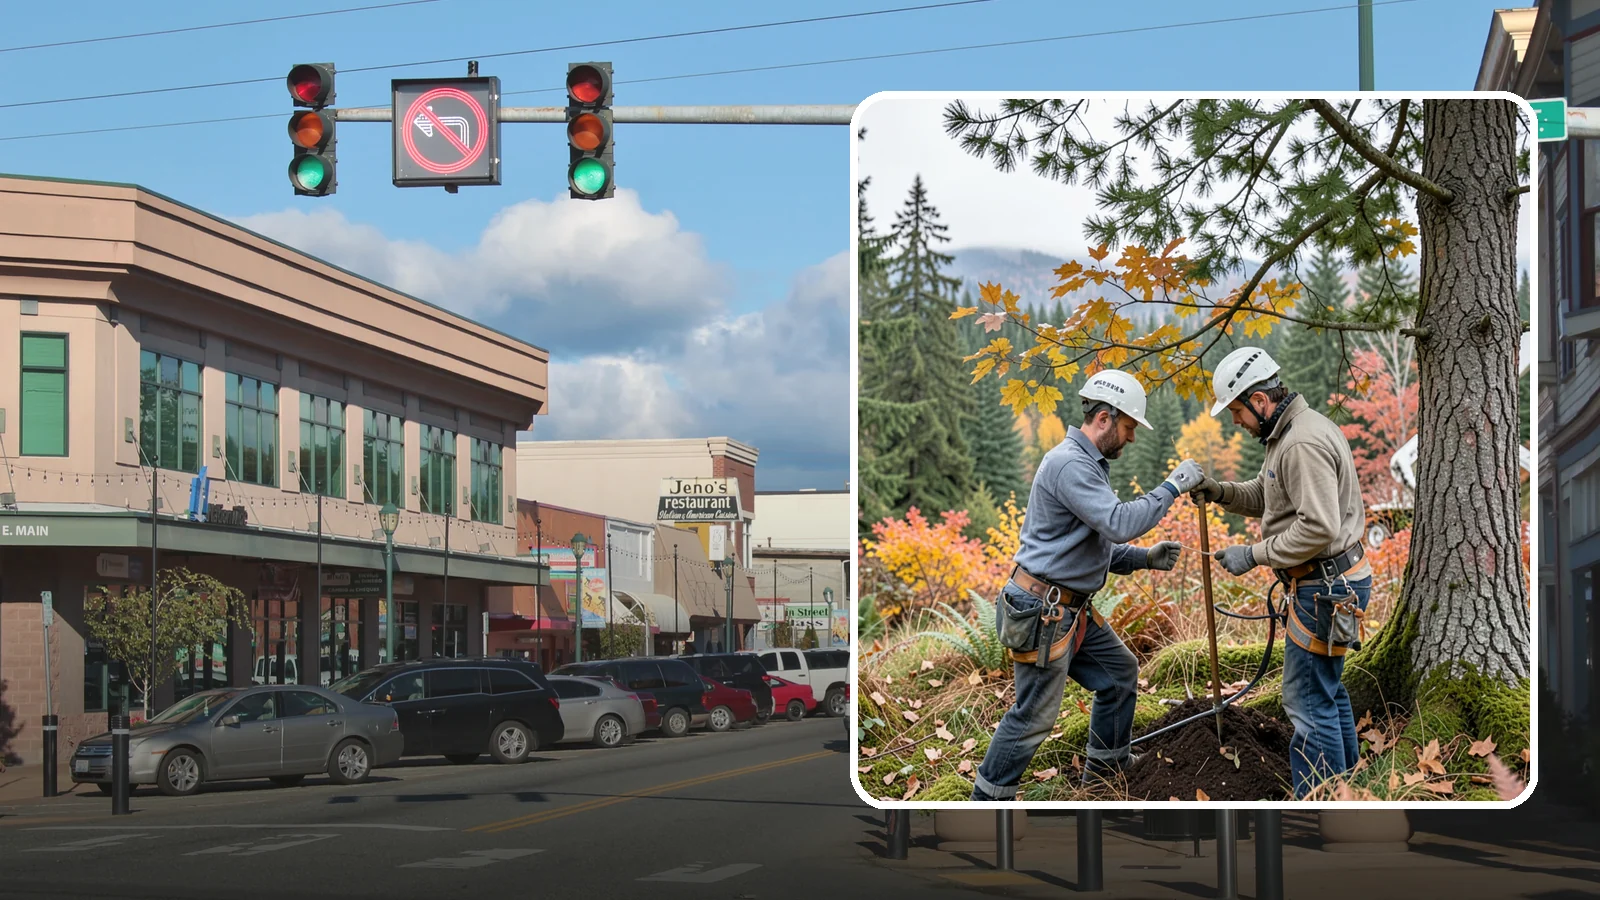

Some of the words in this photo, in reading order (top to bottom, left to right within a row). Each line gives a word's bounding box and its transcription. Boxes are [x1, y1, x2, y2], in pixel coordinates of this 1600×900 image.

[670, 480, 727, 494] Jeno's
[665, 496, 731, 509] restaurant
[659, 510, 681, 519] Italian
[686, 510, 714, 519] American
[715, 509, 737, 519] Cuisine
[2, 525, 12, 536] E.
[16, 525, 49, 536] MAIN
[797, 607, 828, 617] Street
[787, 619, 823, 627] lass
